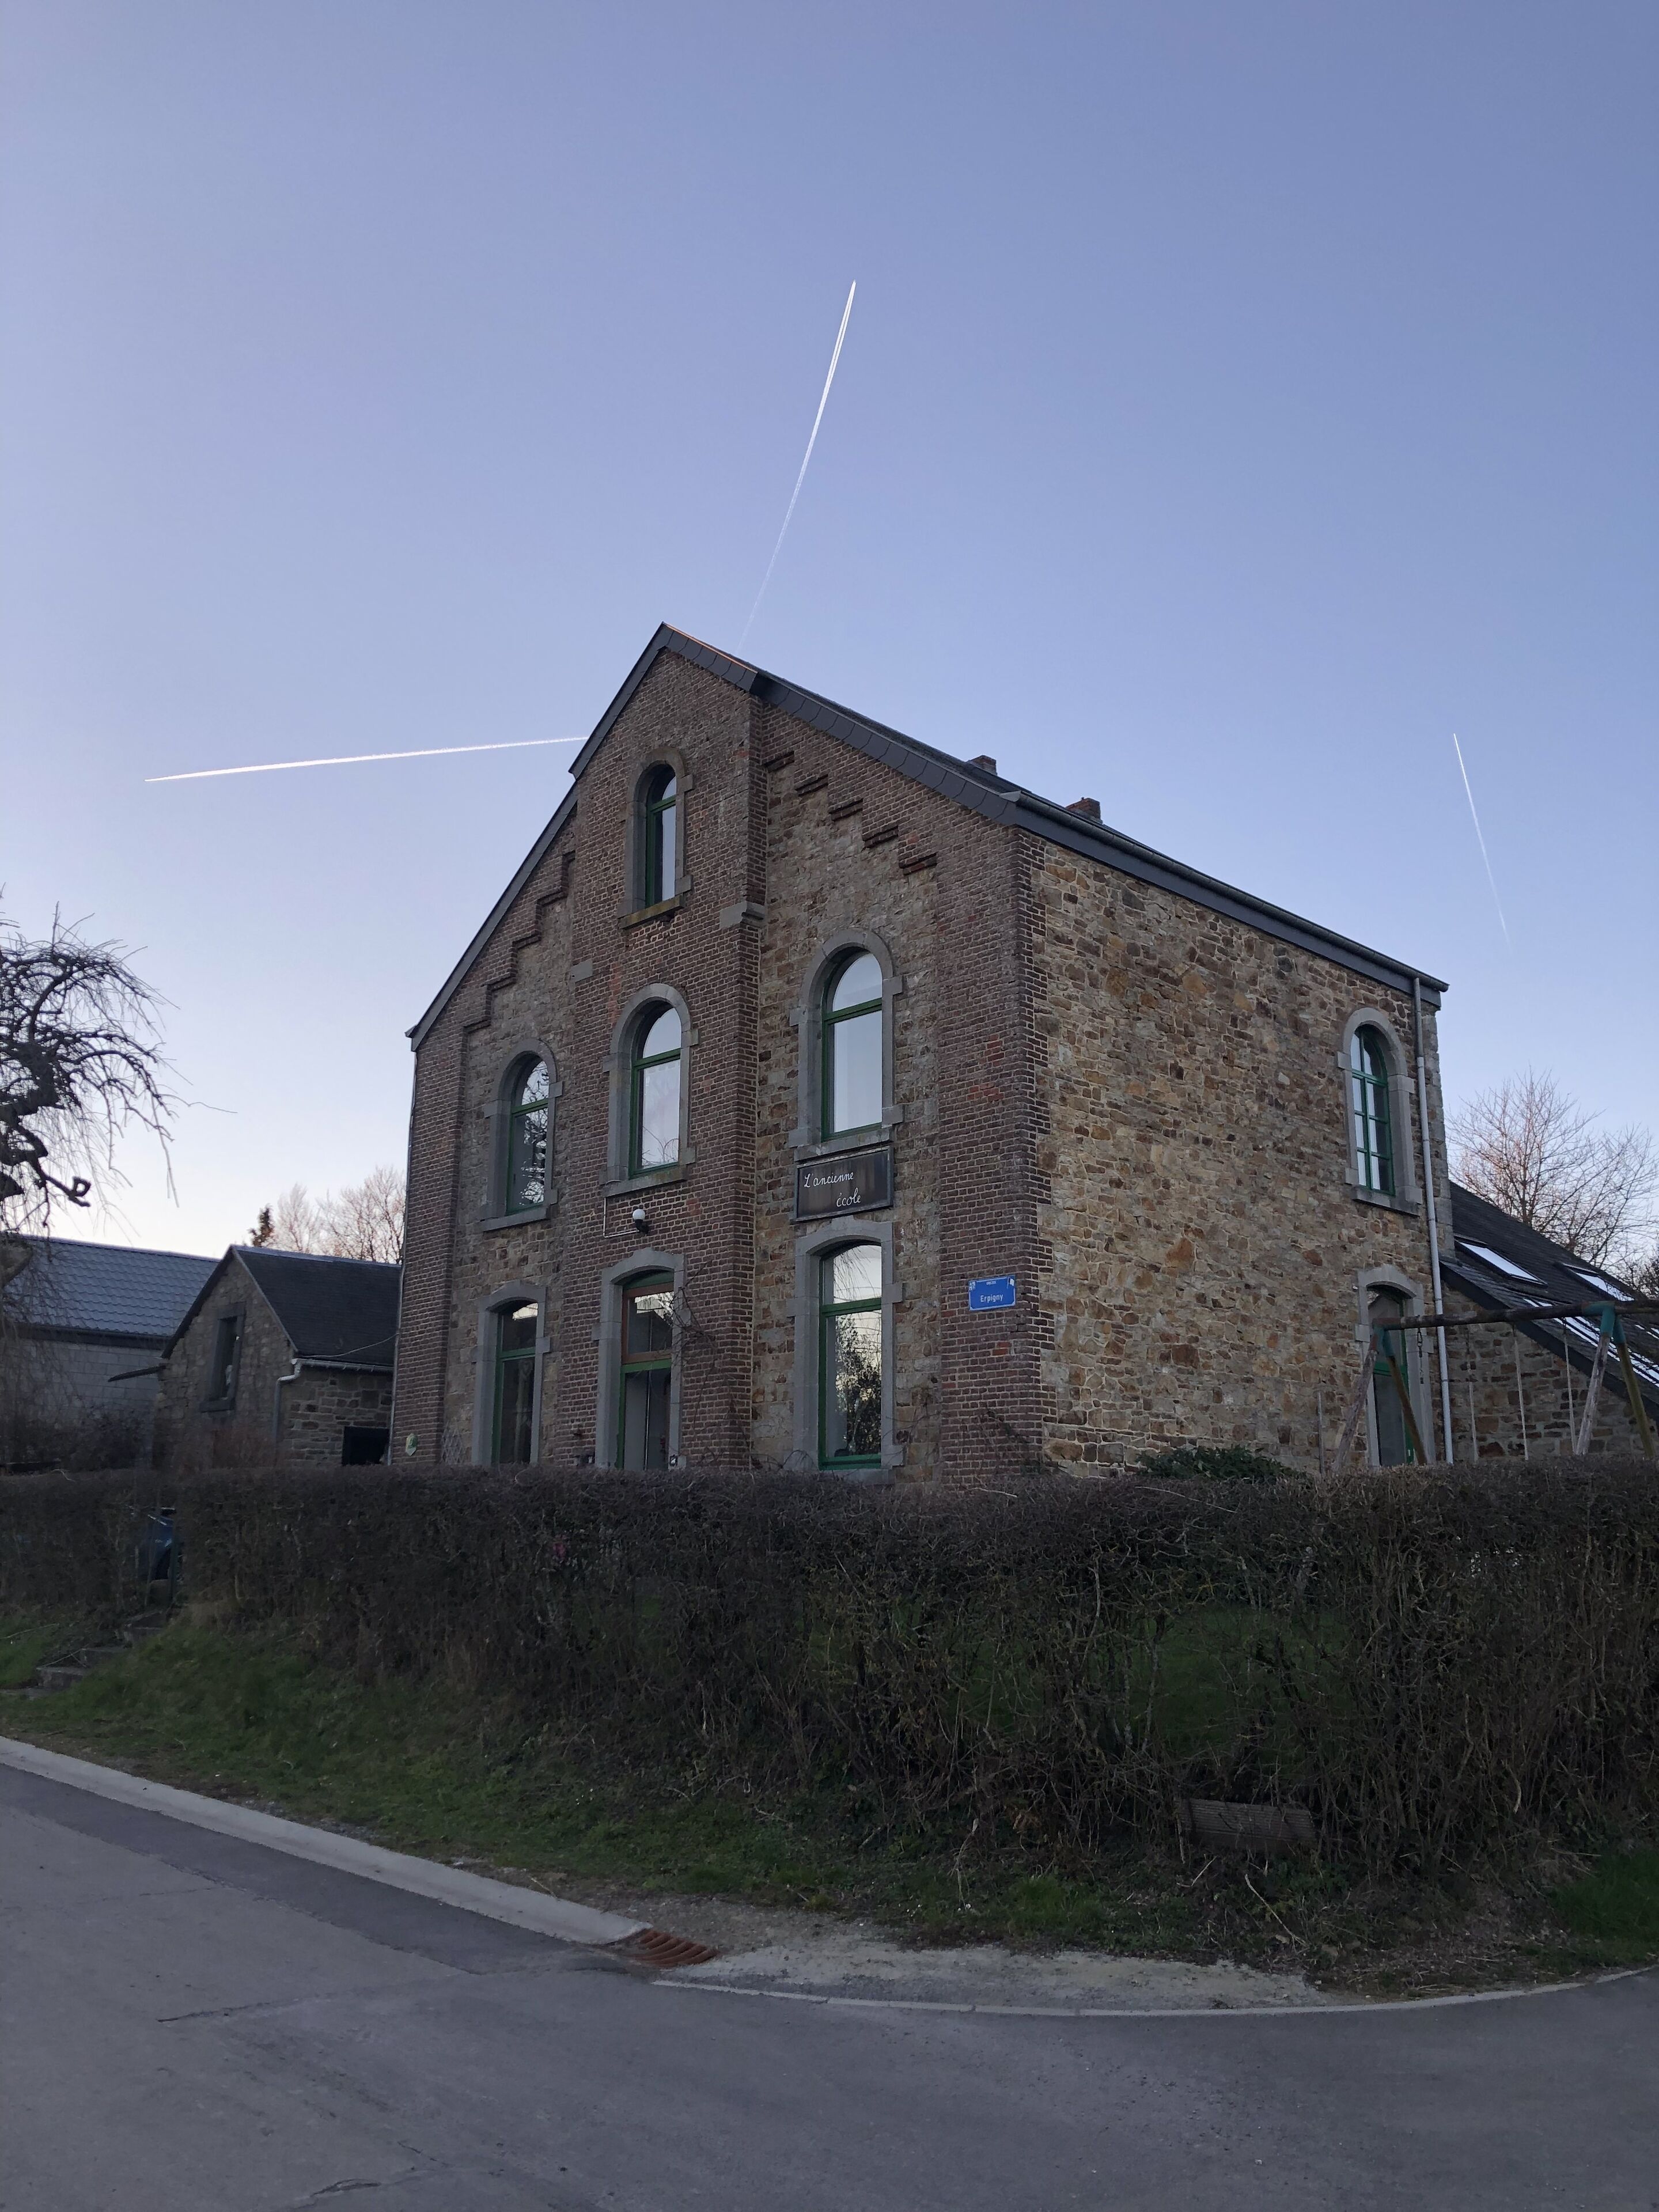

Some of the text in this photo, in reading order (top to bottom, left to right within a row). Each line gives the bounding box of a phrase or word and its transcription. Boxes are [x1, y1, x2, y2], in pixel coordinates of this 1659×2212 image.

[804, 1172, 854, 1188] L'ancienne
[836, 1187, 861, 1207] école
[980, 1294, 1003, 1303] Erpigny
